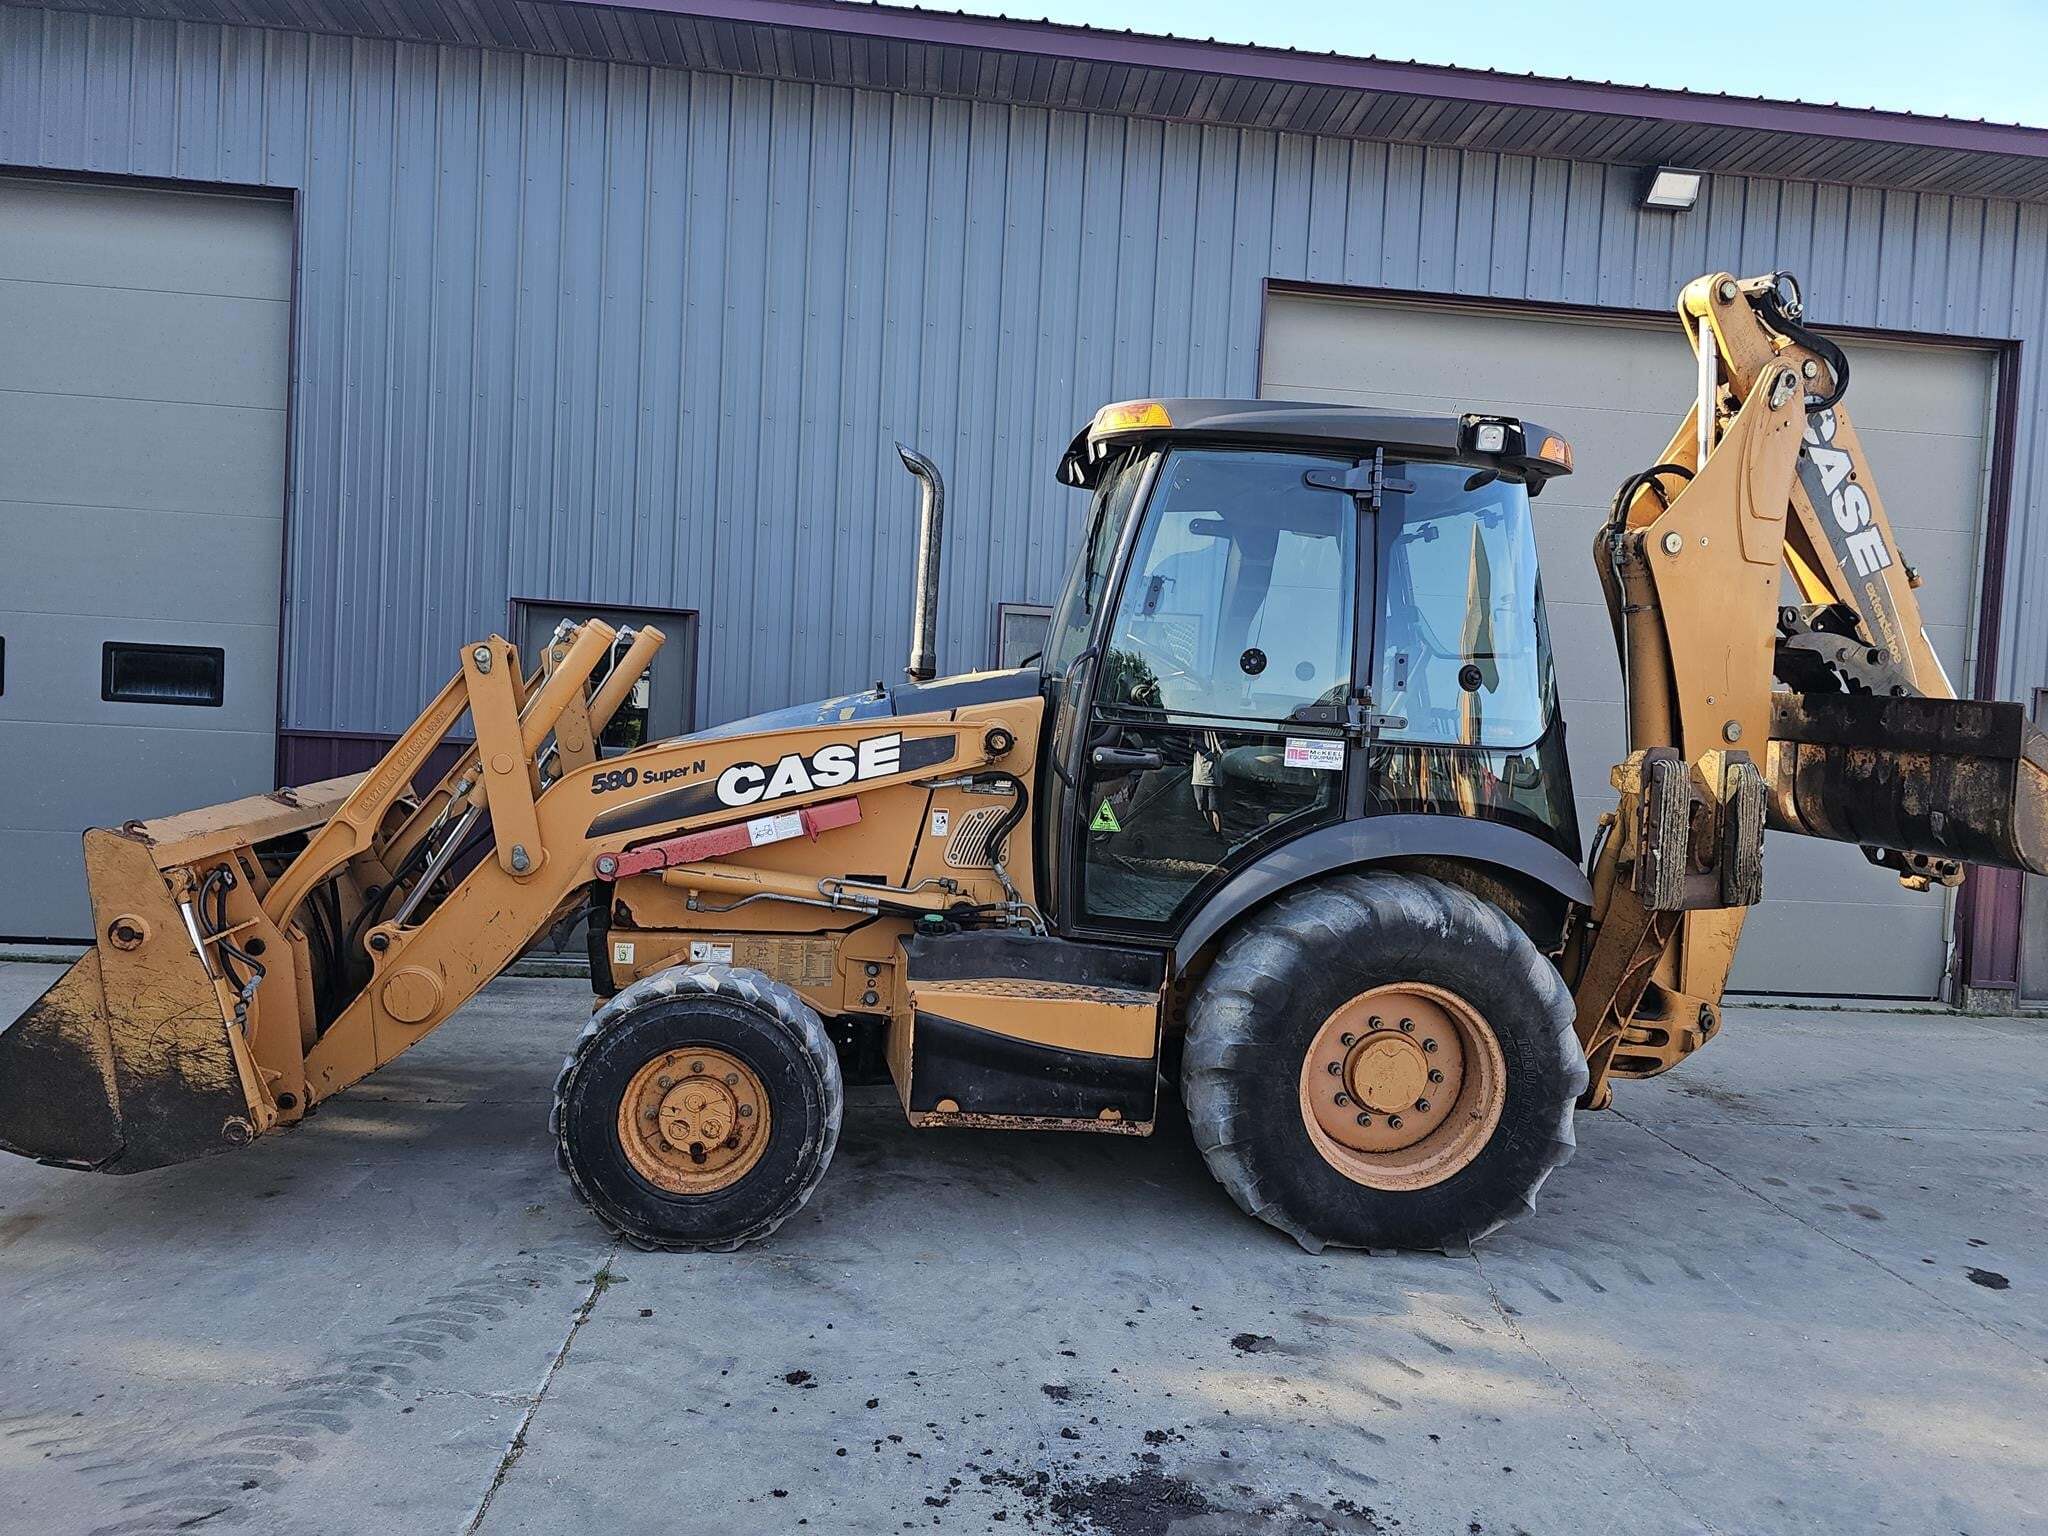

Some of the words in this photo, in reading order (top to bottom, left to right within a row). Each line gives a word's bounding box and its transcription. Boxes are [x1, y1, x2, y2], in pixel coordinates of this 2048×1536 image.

[1803, 396, 1891, 577] CASE
[590, 767, 638, 794] 580
[643, 766, 690, 784] Super
[693, 759, 706, 775] N
[717, 733, 902, 806] CASE
